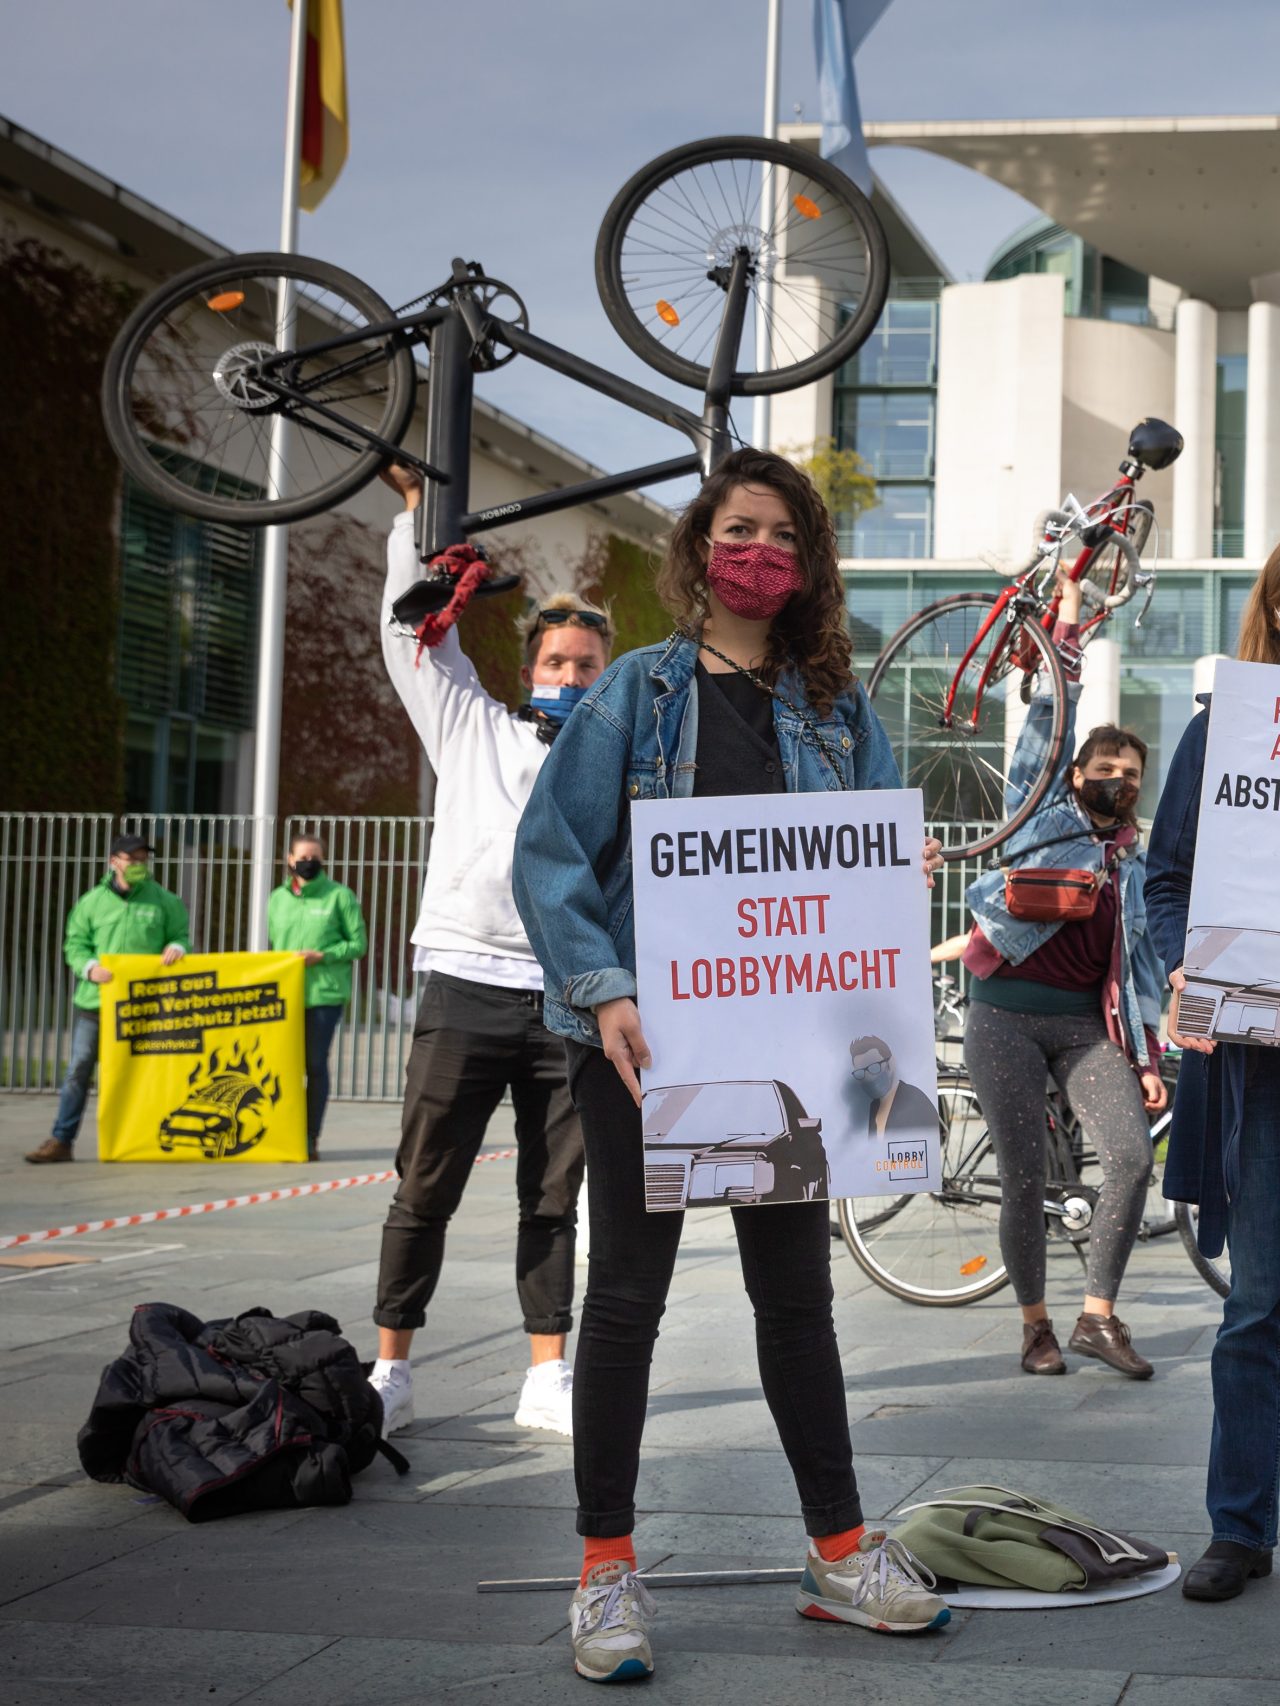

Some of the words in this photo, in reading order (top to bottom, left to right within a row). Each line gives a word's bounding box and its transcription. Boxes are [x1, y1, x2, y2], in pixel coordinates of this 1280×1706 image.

[479, 502, 522, 521] COWBOY
[650, 822, 911, 878] GEMEINWOHL
[737, 895, 830, 938] STATT
[133, 979, 178, 998] Raus
[180, 976, 213, 992] aus
[671, 948, 901, 1001] LOBBYMACHT
[118, 1001, 160, 1018] dem
[161, 988, 262, 1013] Verbrenner
[121, 1010, 234, 1036] Klimaschutz
[234, 1002, 283, 1026] jetzt!
[876, 1158, 924, 1172] CONTROL
[891, 1150, 925, 1163] LOBBY
